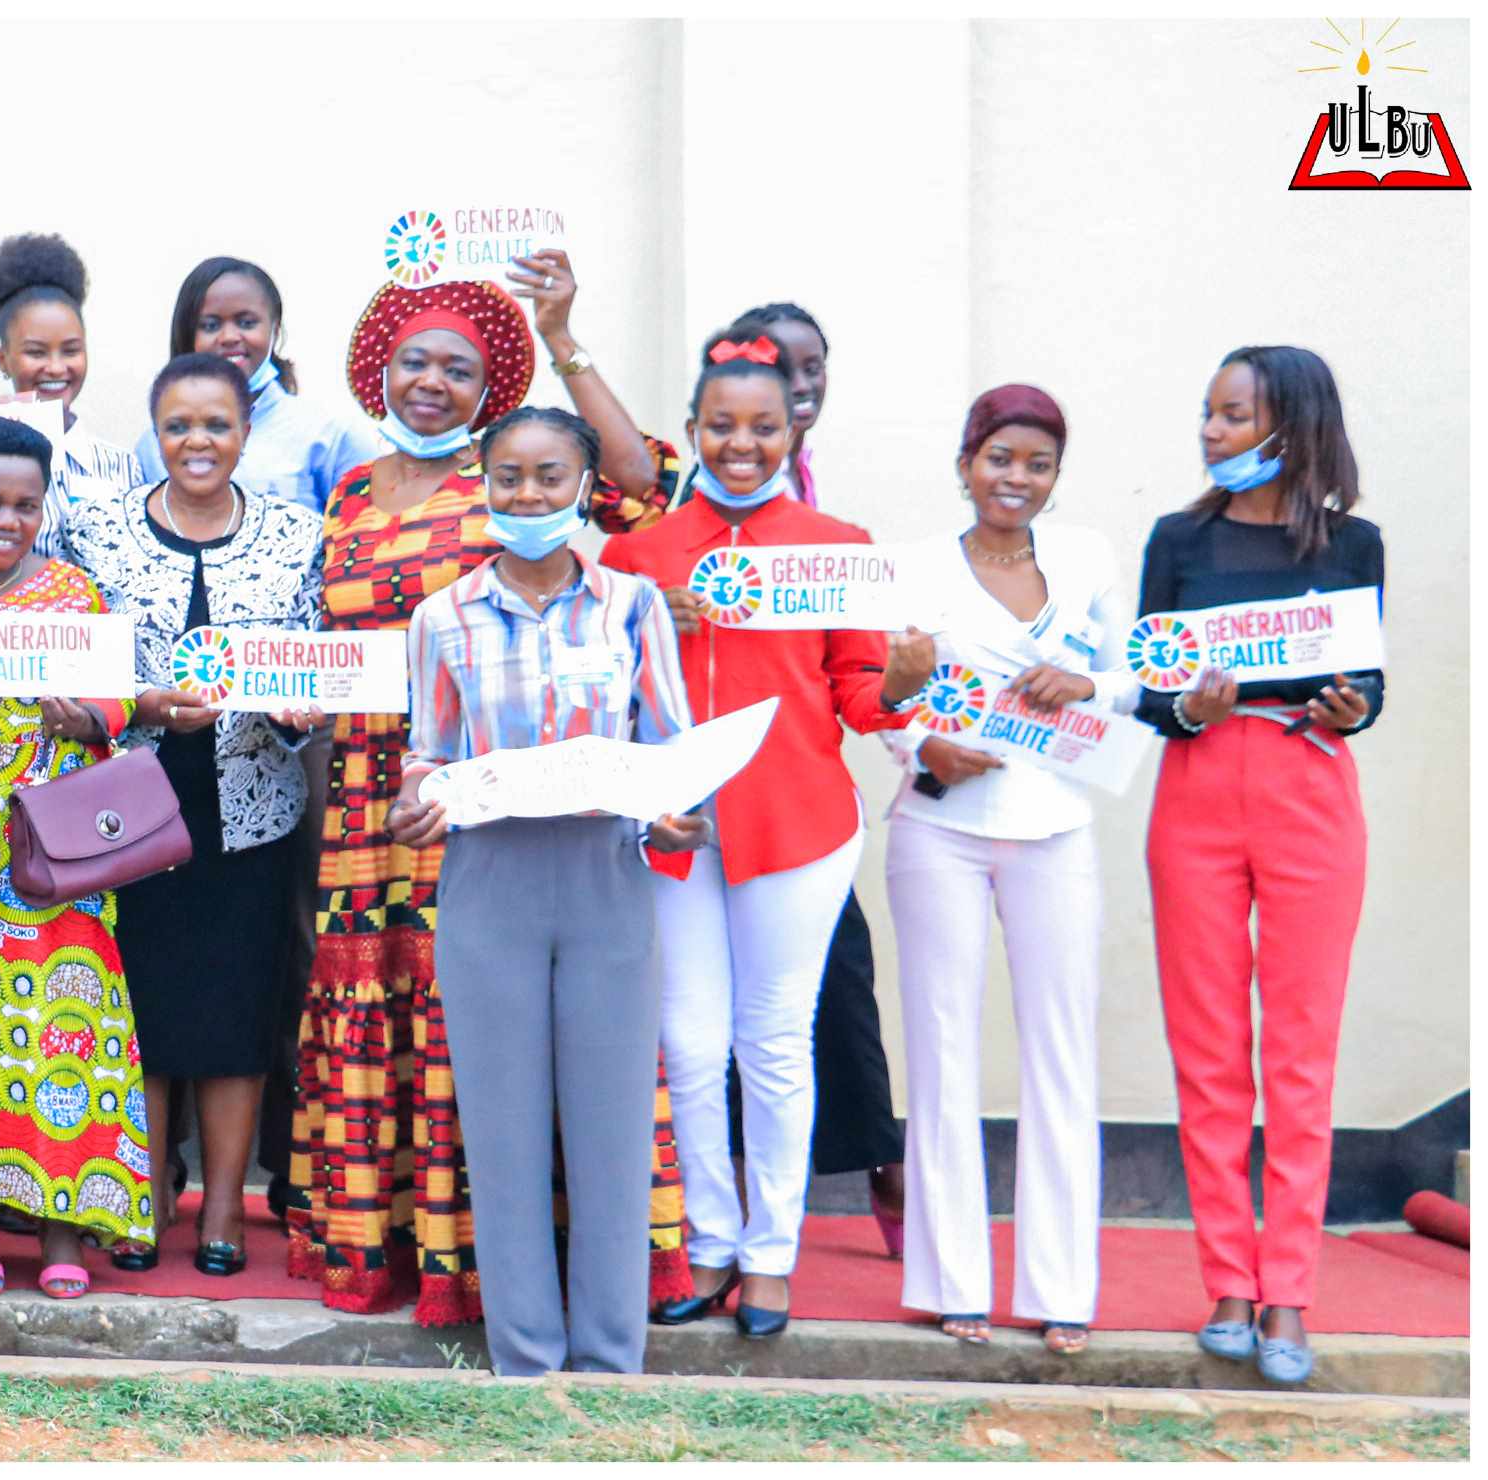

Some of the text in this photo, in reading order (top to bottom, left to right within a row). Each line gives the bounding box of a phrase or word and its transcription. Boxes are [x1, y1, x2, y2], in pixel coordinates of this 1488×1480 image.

[455, 206, 565, 236] GÉNÉRATION
[772, 554, 895, 584] GÉNÉRATION
[773, 584, 846, 614] ÉGALITÉ
[1205, 604, 1333, 644] GÉNÉRATION
[243, 637, 364, 668] GÉNÉRATION
[1209, 636, 1288, 670] ÉGALITÉ
[243, 668, 319, 698] ÉGALITÉ
[981, 712, 1055, 755] ÉGALITÉ
[7, 926, 36, 938] SOKO
